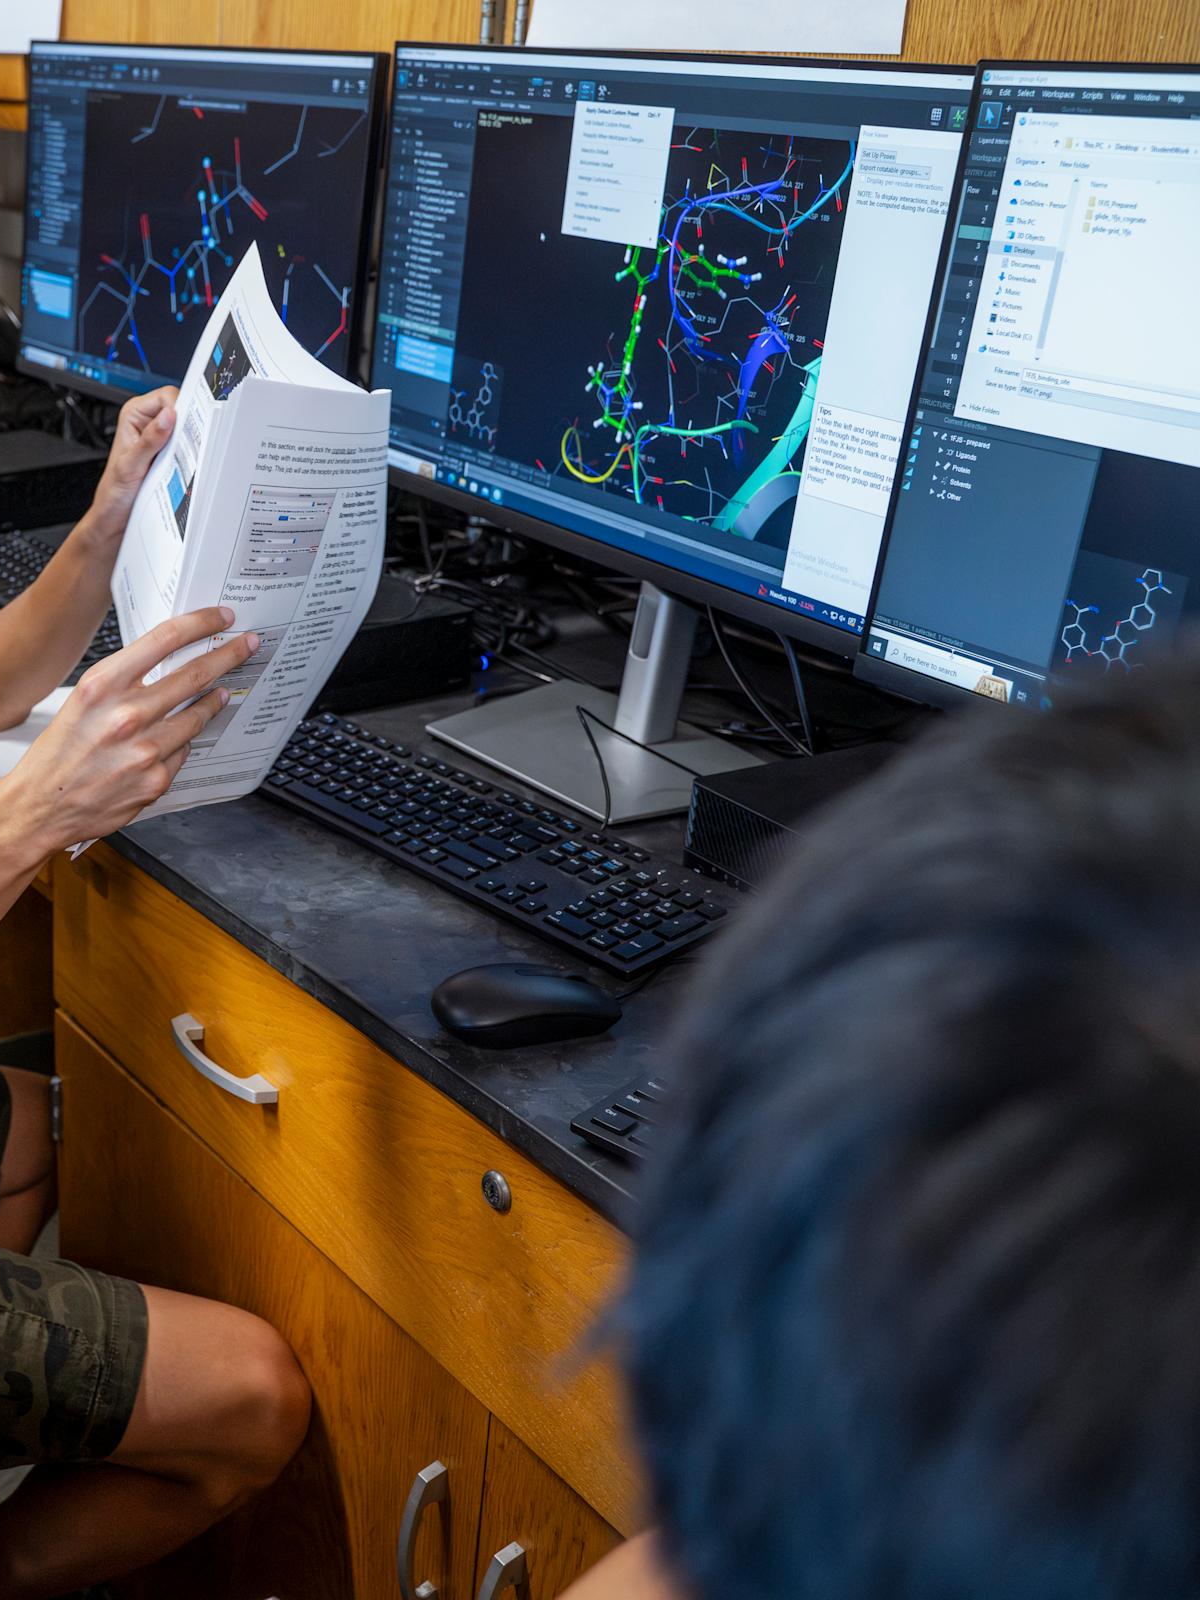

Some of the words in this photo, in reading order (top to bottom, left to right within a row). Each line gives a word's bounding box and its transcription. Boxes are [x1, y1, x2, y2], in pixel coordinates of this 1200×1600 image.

[982, 87, 993, 96] File
[999, 88, 1012, 97] Edit
[1017, 89, 1035, 98] Select
[1042, 90, 1075, 99] Workspace
[1081, 91, 1104, 101] Scripts
[1110, 92, 1126, 101] View
[1133, 93, 1161, 102] Window
[1167, 94, 1184, 104] Help
[978, 137, 994, 145] Ligand
[880, 152, 896, 161] Poses
[860, 163, 876, 172] Export
[876, 165, 899, 174] rotatable
[1059, 160, 1072, 168] New
[915, 182, 944, 192] interactions
[1023, 179, 1049, 188] OneDrive
[967, 185, 980, 195] Row
[881, 192, 898, 202] display
[876, 201, 900, 211] computed
[901, 204, 918, 214] during
[1020, 198, 1044, 208] OneDrive
[1025, 232, 1045, 242] Objects
[1013, 245, 1036, 256] Desktop
[1010, 260, 1041, 271] Documents
[1007, 274, 1037, 285] Downloads
[1005, 288, 1021, 297] Music
[1002, 301, 1023, 311] Pictures
[998, 315, 1017, 325] Videos
[995, 329, 1011, 338] Local
[1010, 331, 1021, 339] Disk
[950, 353, 958, 361] 10
[988, 346, 1011, 357] Network
[945, 377, 953, 385] 11
[943, 389, 951, 397] 12
[1020, 385, 1033, 395] PNG
[919, 397, 951, 410] STRUCTURE
[819, 406, 832, 416] Tips
[969, 403, 981, 413] Hide
[982, 406, 1000, 416] Folders
[943, 415, 963, 428] Current
[815, 426, 828, 436] step
[828, 428, 850, 441] through
[850, 434, 861, 442] the
[820, 417, 833, 426] Use
[833, 420, 843, 429] the
[843, 422, 853, 432] left
[853, 426, 865, 435] and
[865, 428, 880, 439] right
[879, 433, 898, 442] arrow
[267, 441, 277, 449] this
[278, 443, 296, 452] section,
[817, 436, 830, 446] Use
[829, 440, 839, 449] the
[845, 443, 856, 454] key
[864, 449, 879, 459] mark
[965, 437, 991, 450] prepared
[257, 452, 268, 460] can
[268, 453, 280, 461] help
[280, 454, 291, 462] with
[291, 456, 314, 465] evaluating
[811, 445, 833, 456] current
[832, 450, 848, 461] pose
[955, 450, 977, 462] Ligands
[275, 464, 285, 473] This
[821, 457, 835, 467] view
[834, 461, 853, 472] poses
[853, 465, 862, 474] for
[862, 468, 885, 481] existing
[951, 463, 972, 475] Protein
[808, 464, 825, 475] select
[825, 468, 835, 477] the
[835, 471, 851, 482] entry
[851, 476, 869, 488] group
[869, 480, 881, 490] and
[949, 477, 973, 490] Solvents
[946, 491, 962, 502] Other
[225, 583, 242, 593] Figure
[221, 593, 244, 603] Docking
[769, 589, 788, 603] Nasdaq
[787, 596, 798, 606] 100
[903, 652, 916, 664] Type
[916, 656, 930, 669] here
[938, 665, 958, 677] search
